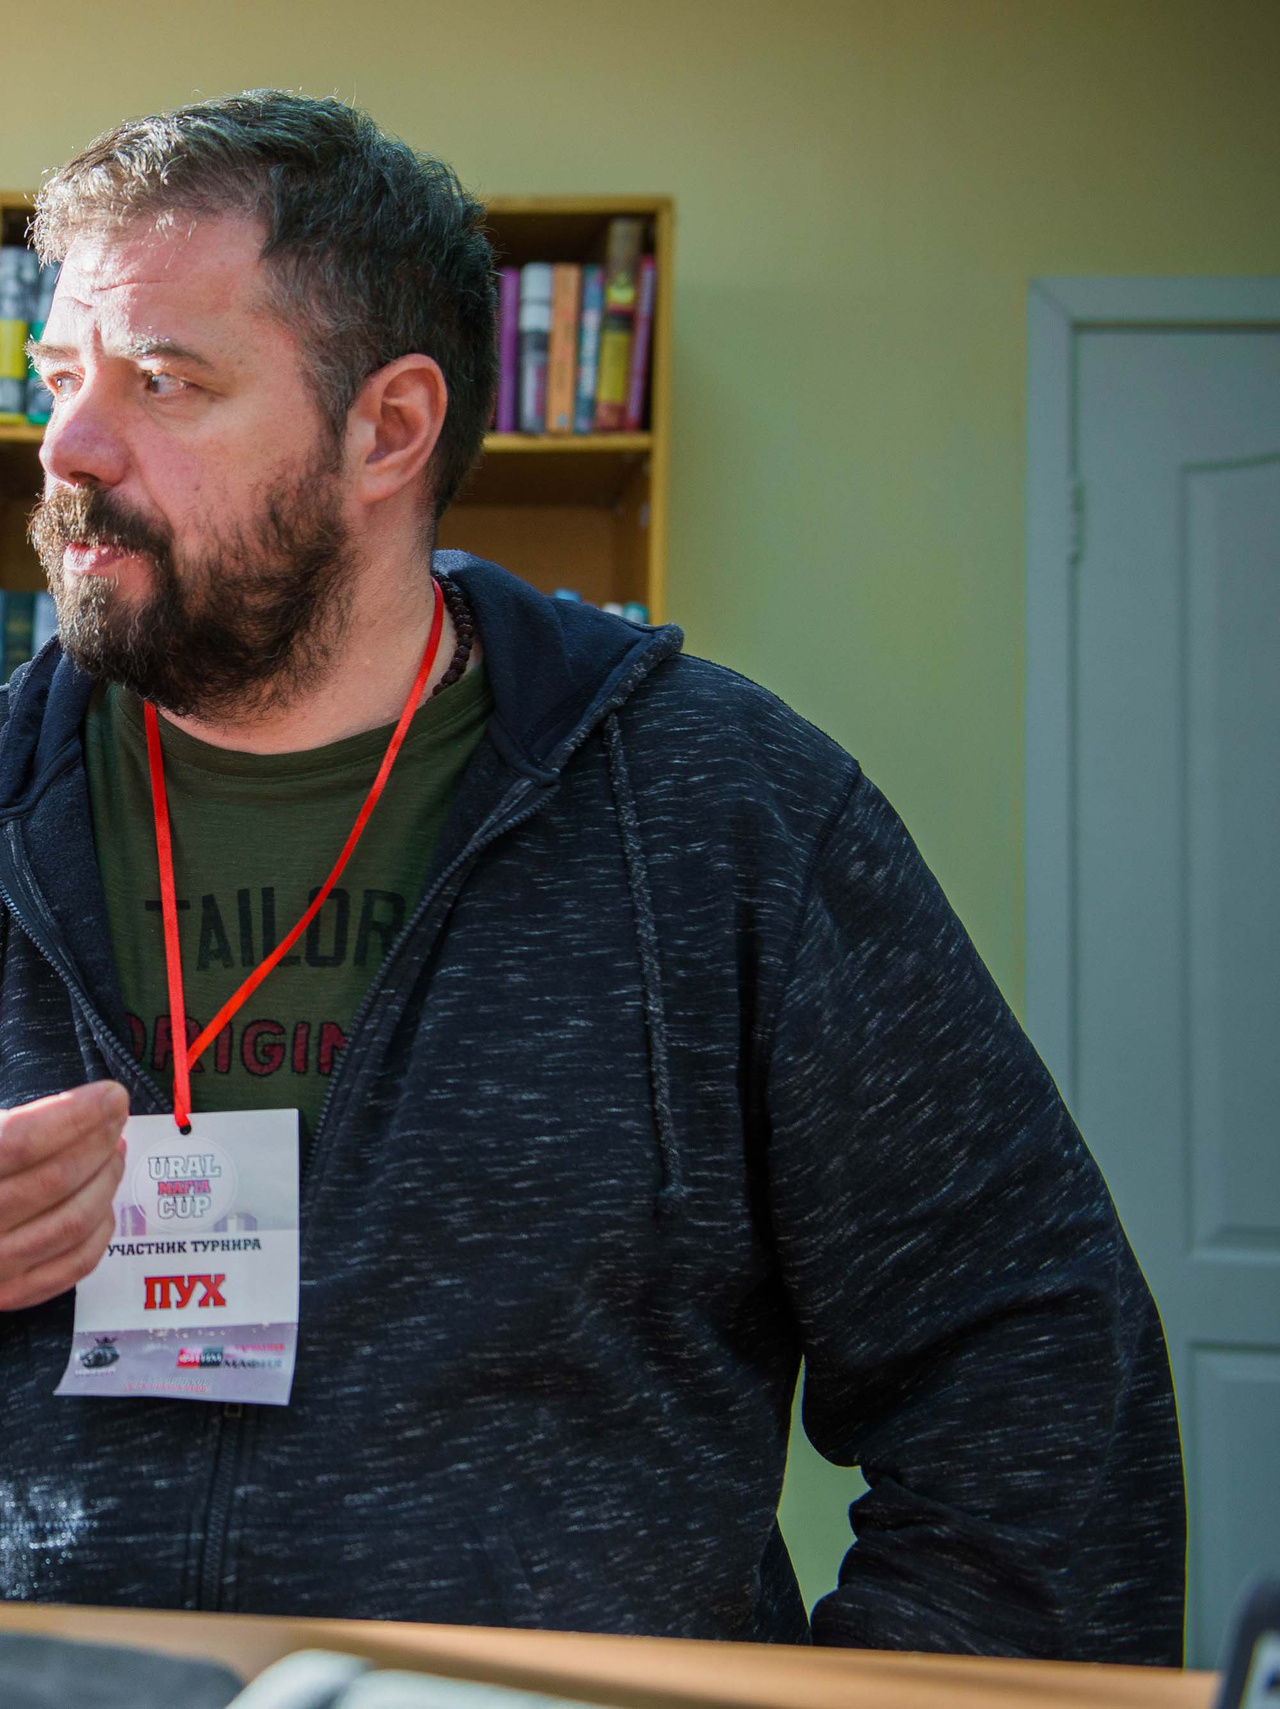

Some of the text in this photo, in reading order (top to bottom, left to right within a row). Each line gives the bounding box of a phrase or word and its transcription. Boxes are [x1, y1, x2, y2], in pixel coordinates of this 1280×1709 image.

[145, 887, 406, 971] TAILOR
[148, 1154, 221, 1180] URAL
[158, 1179, 211, 1195] MAFIA
[157, 1195, 211, 1219] CUP
[108, 1238, 262, 1257] УЧАСТНИК ТУРНИРА
[143, 1274, 227, 1310] ПУХ
